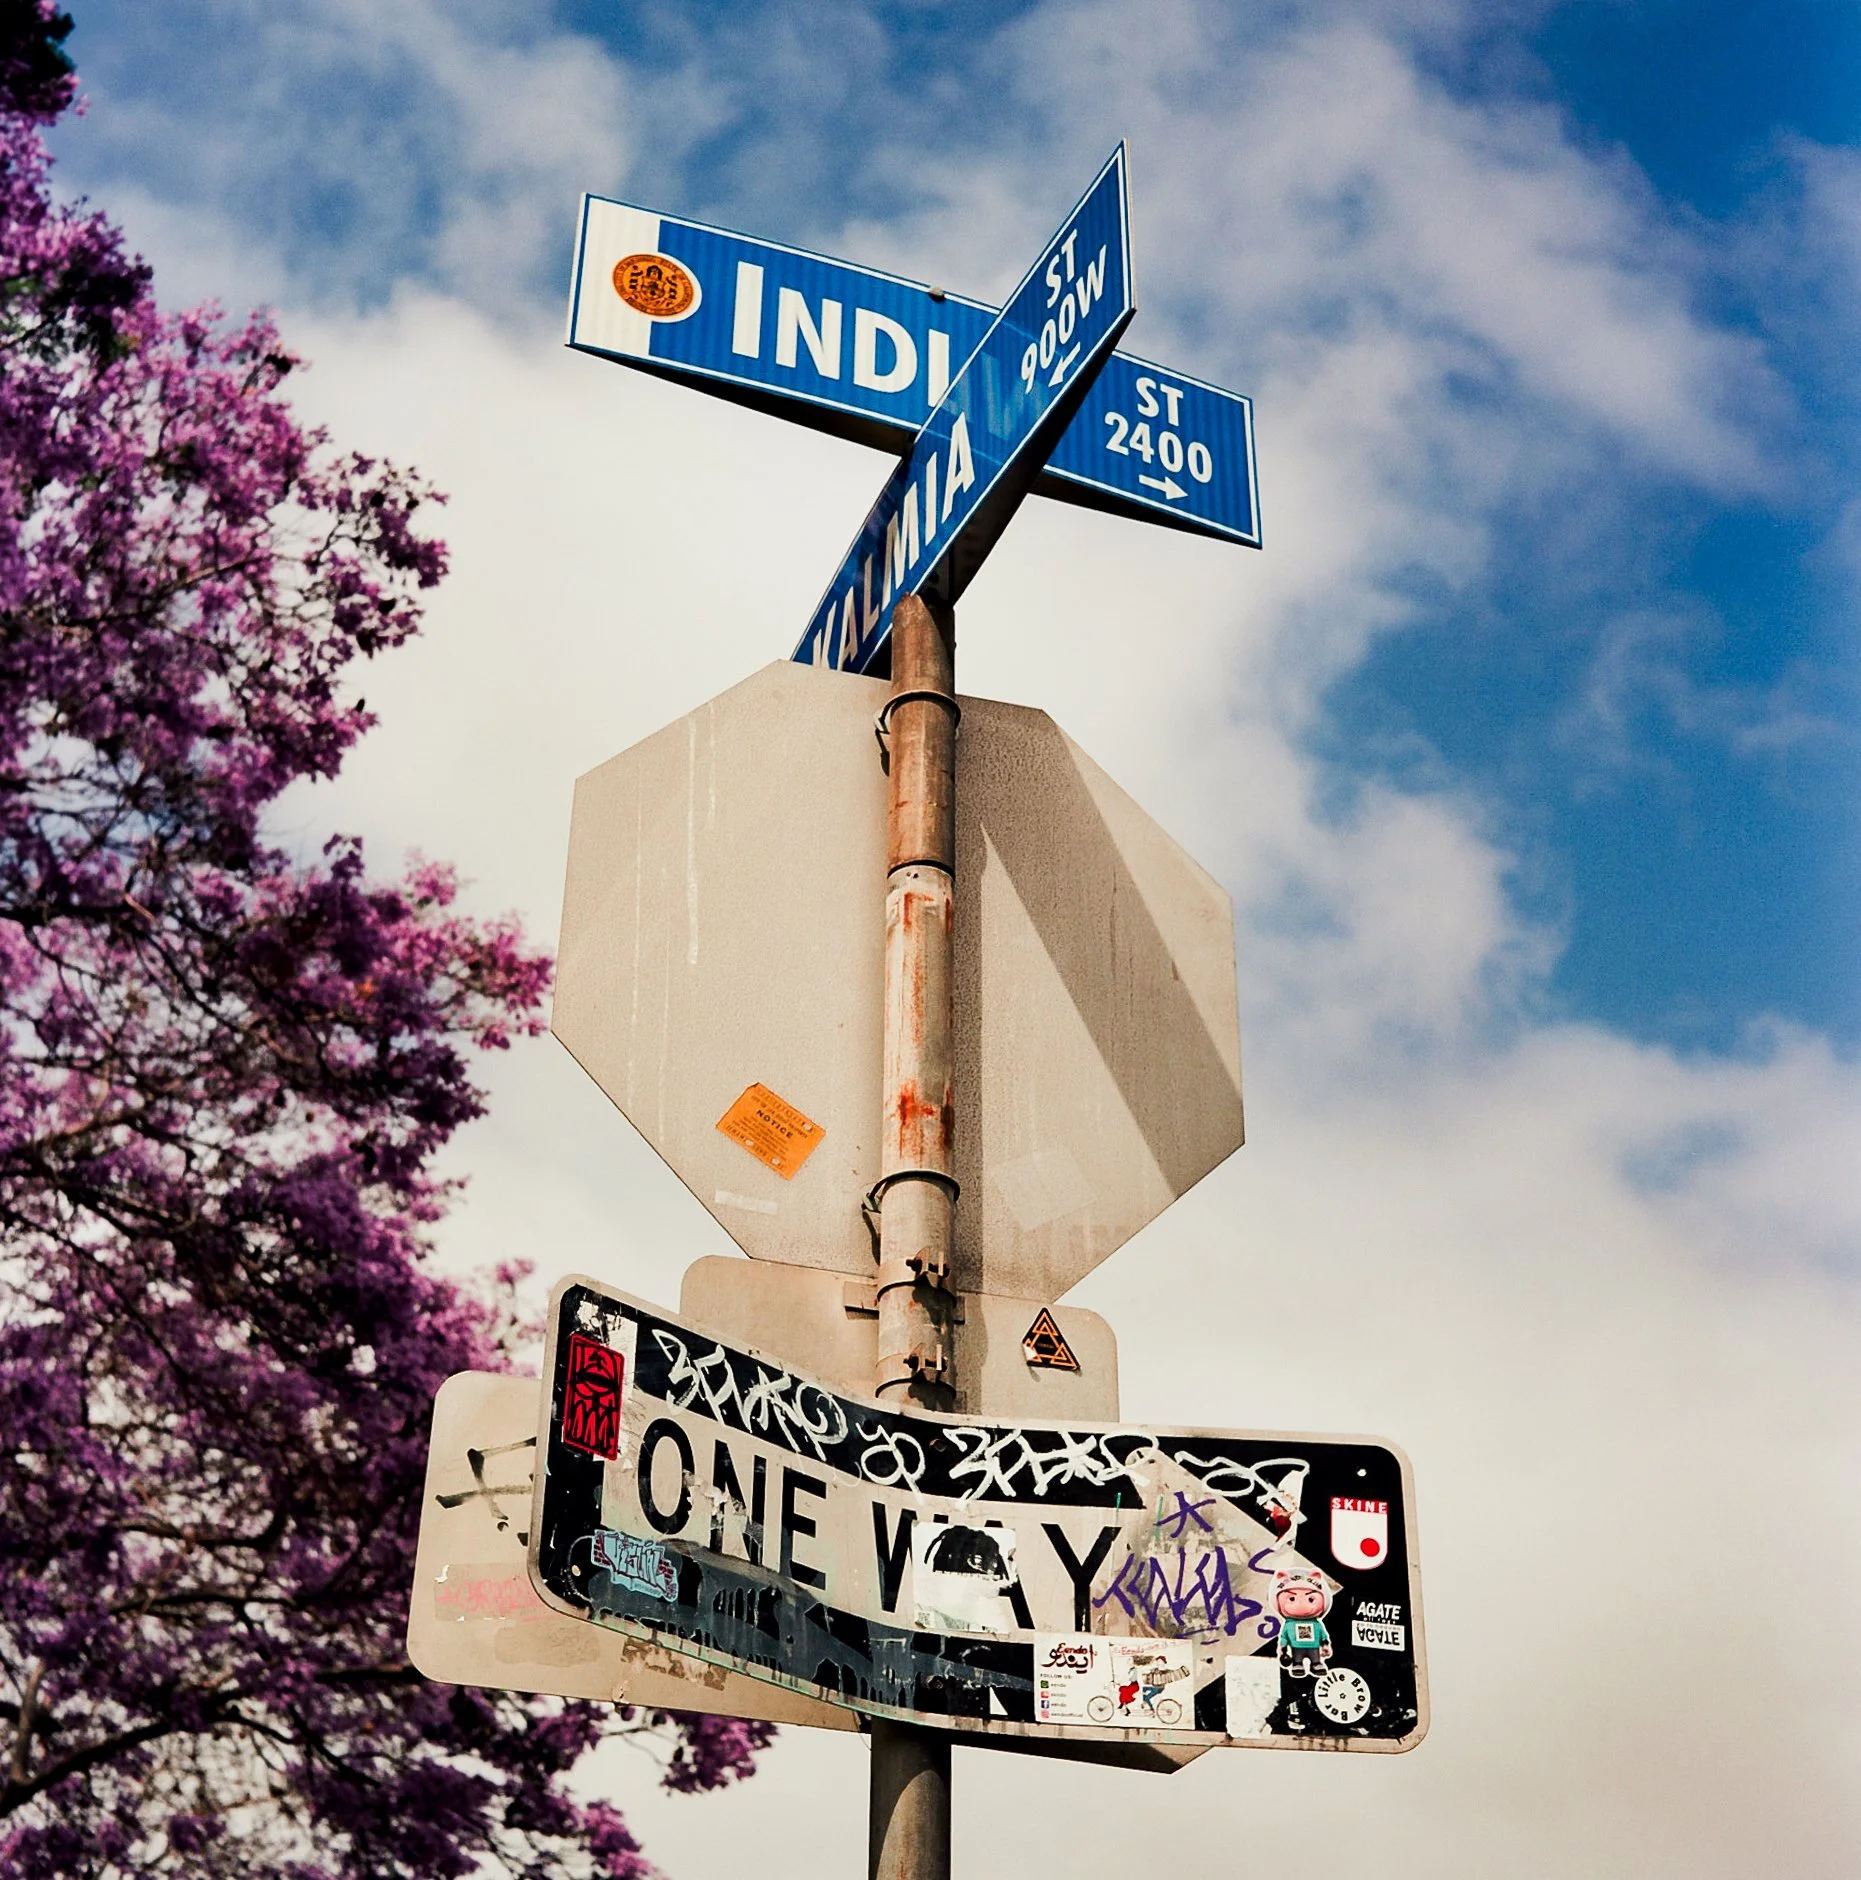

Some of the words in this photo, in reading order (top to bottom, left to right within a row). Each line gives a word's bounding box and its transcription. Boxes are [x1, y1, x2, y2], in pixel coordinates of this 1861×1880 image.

[1045, 228, 1082, 308] ST
[732, 261, 950, 407] INDI
[1135, 376, 1184, 427] ST
[1021, 244, 1107, 393] 900W
[1105, 411, 1212, 484] 2400
[812, 412, 976, 671] KALMIA
[756, 1109, 793, 1139] NOTICE
[637, 1417, 828, 1591] ONE
[1332, 1498, 1388, 1514] SKINE
[1356, 1601, 1401, 1620] AGATE
[1317, 1671, 1346, 1698] Little
[1351, 1677, 1366, 1714] Brow
[1325, 1704, 1348, 1721] Bar
